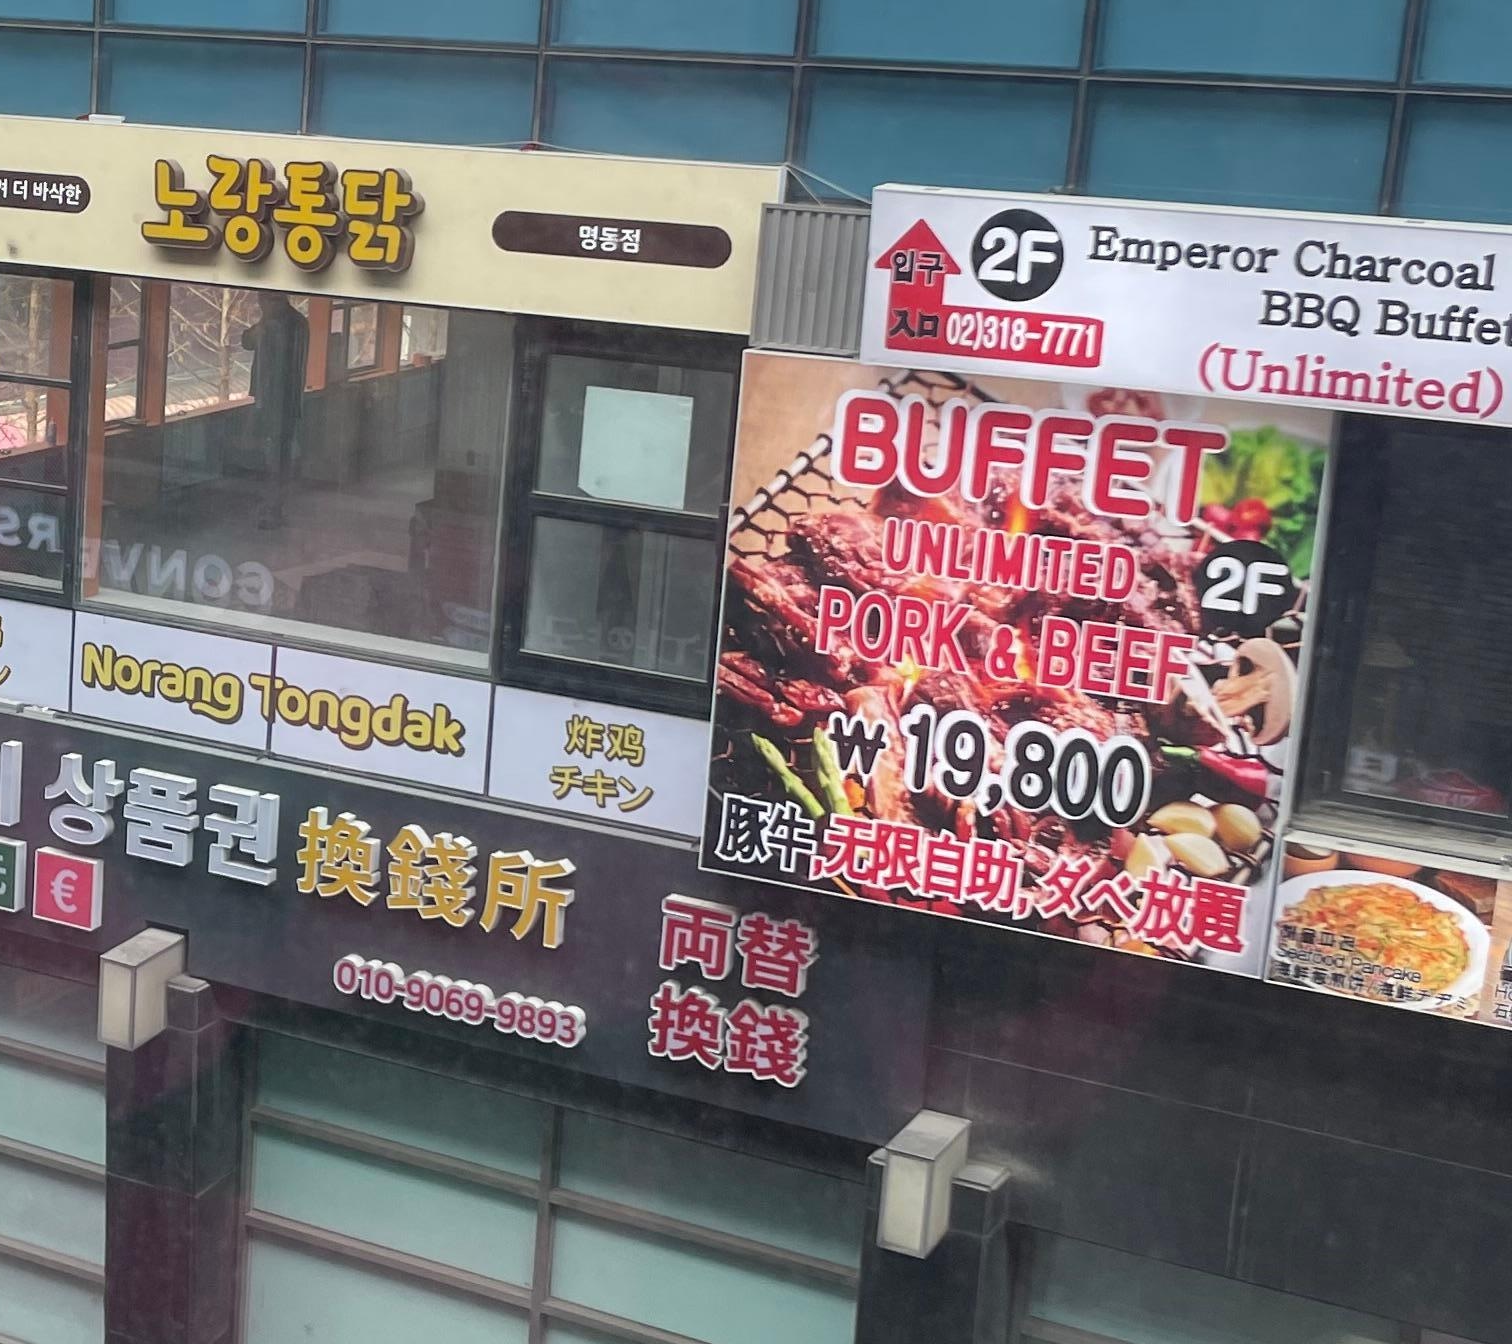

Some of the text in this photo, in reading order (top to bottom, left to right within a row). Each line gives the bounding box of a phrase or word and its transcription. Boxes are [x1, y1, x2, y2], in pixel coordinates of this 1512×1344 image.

[12, 180, 28, 200] 더
[33, 181, 82, 206] 바삭한
[141, 153, 424, 273] 노랑통닭
[577, 221, 642, 255] 명동점
[891, 247, 945, 286] 입구
[976, 225, 1059, 284] 2F
[1088, 225, 1497, 292] Emperor Charcoal
[889, 307, 940, 340] 入口
[945, 316, 1097, 359] 02)318-7771
[1259, 290, 1363, 336] BBQ
[1198, 341, 1505, 420] (Unlimited)
[833, 389, 1229, 527] BUFFET
[882, 516, 1137, 603] UNLIMITED
[1202, 555, 1290, 615] 2F
[815, 585, 1200, 705] PORK & BEEF
[82, 642, 466, 758] Norang Tongdak
[564, 715, 648, 768] 炸鸡
[44, 751, 281, 886] 상품권
[549, 766, 654, 815] チキン
[50, 869, 79, 914] €
[296, 805, 576, 950] 換錢所
[659, 893, 819, 998] 両替
[1276, 946, 1422, 983] Seafood Pancake
[333, 954, 586, 1048] 010-9069-9893
[649, 980, 810, 1088] 換錢
